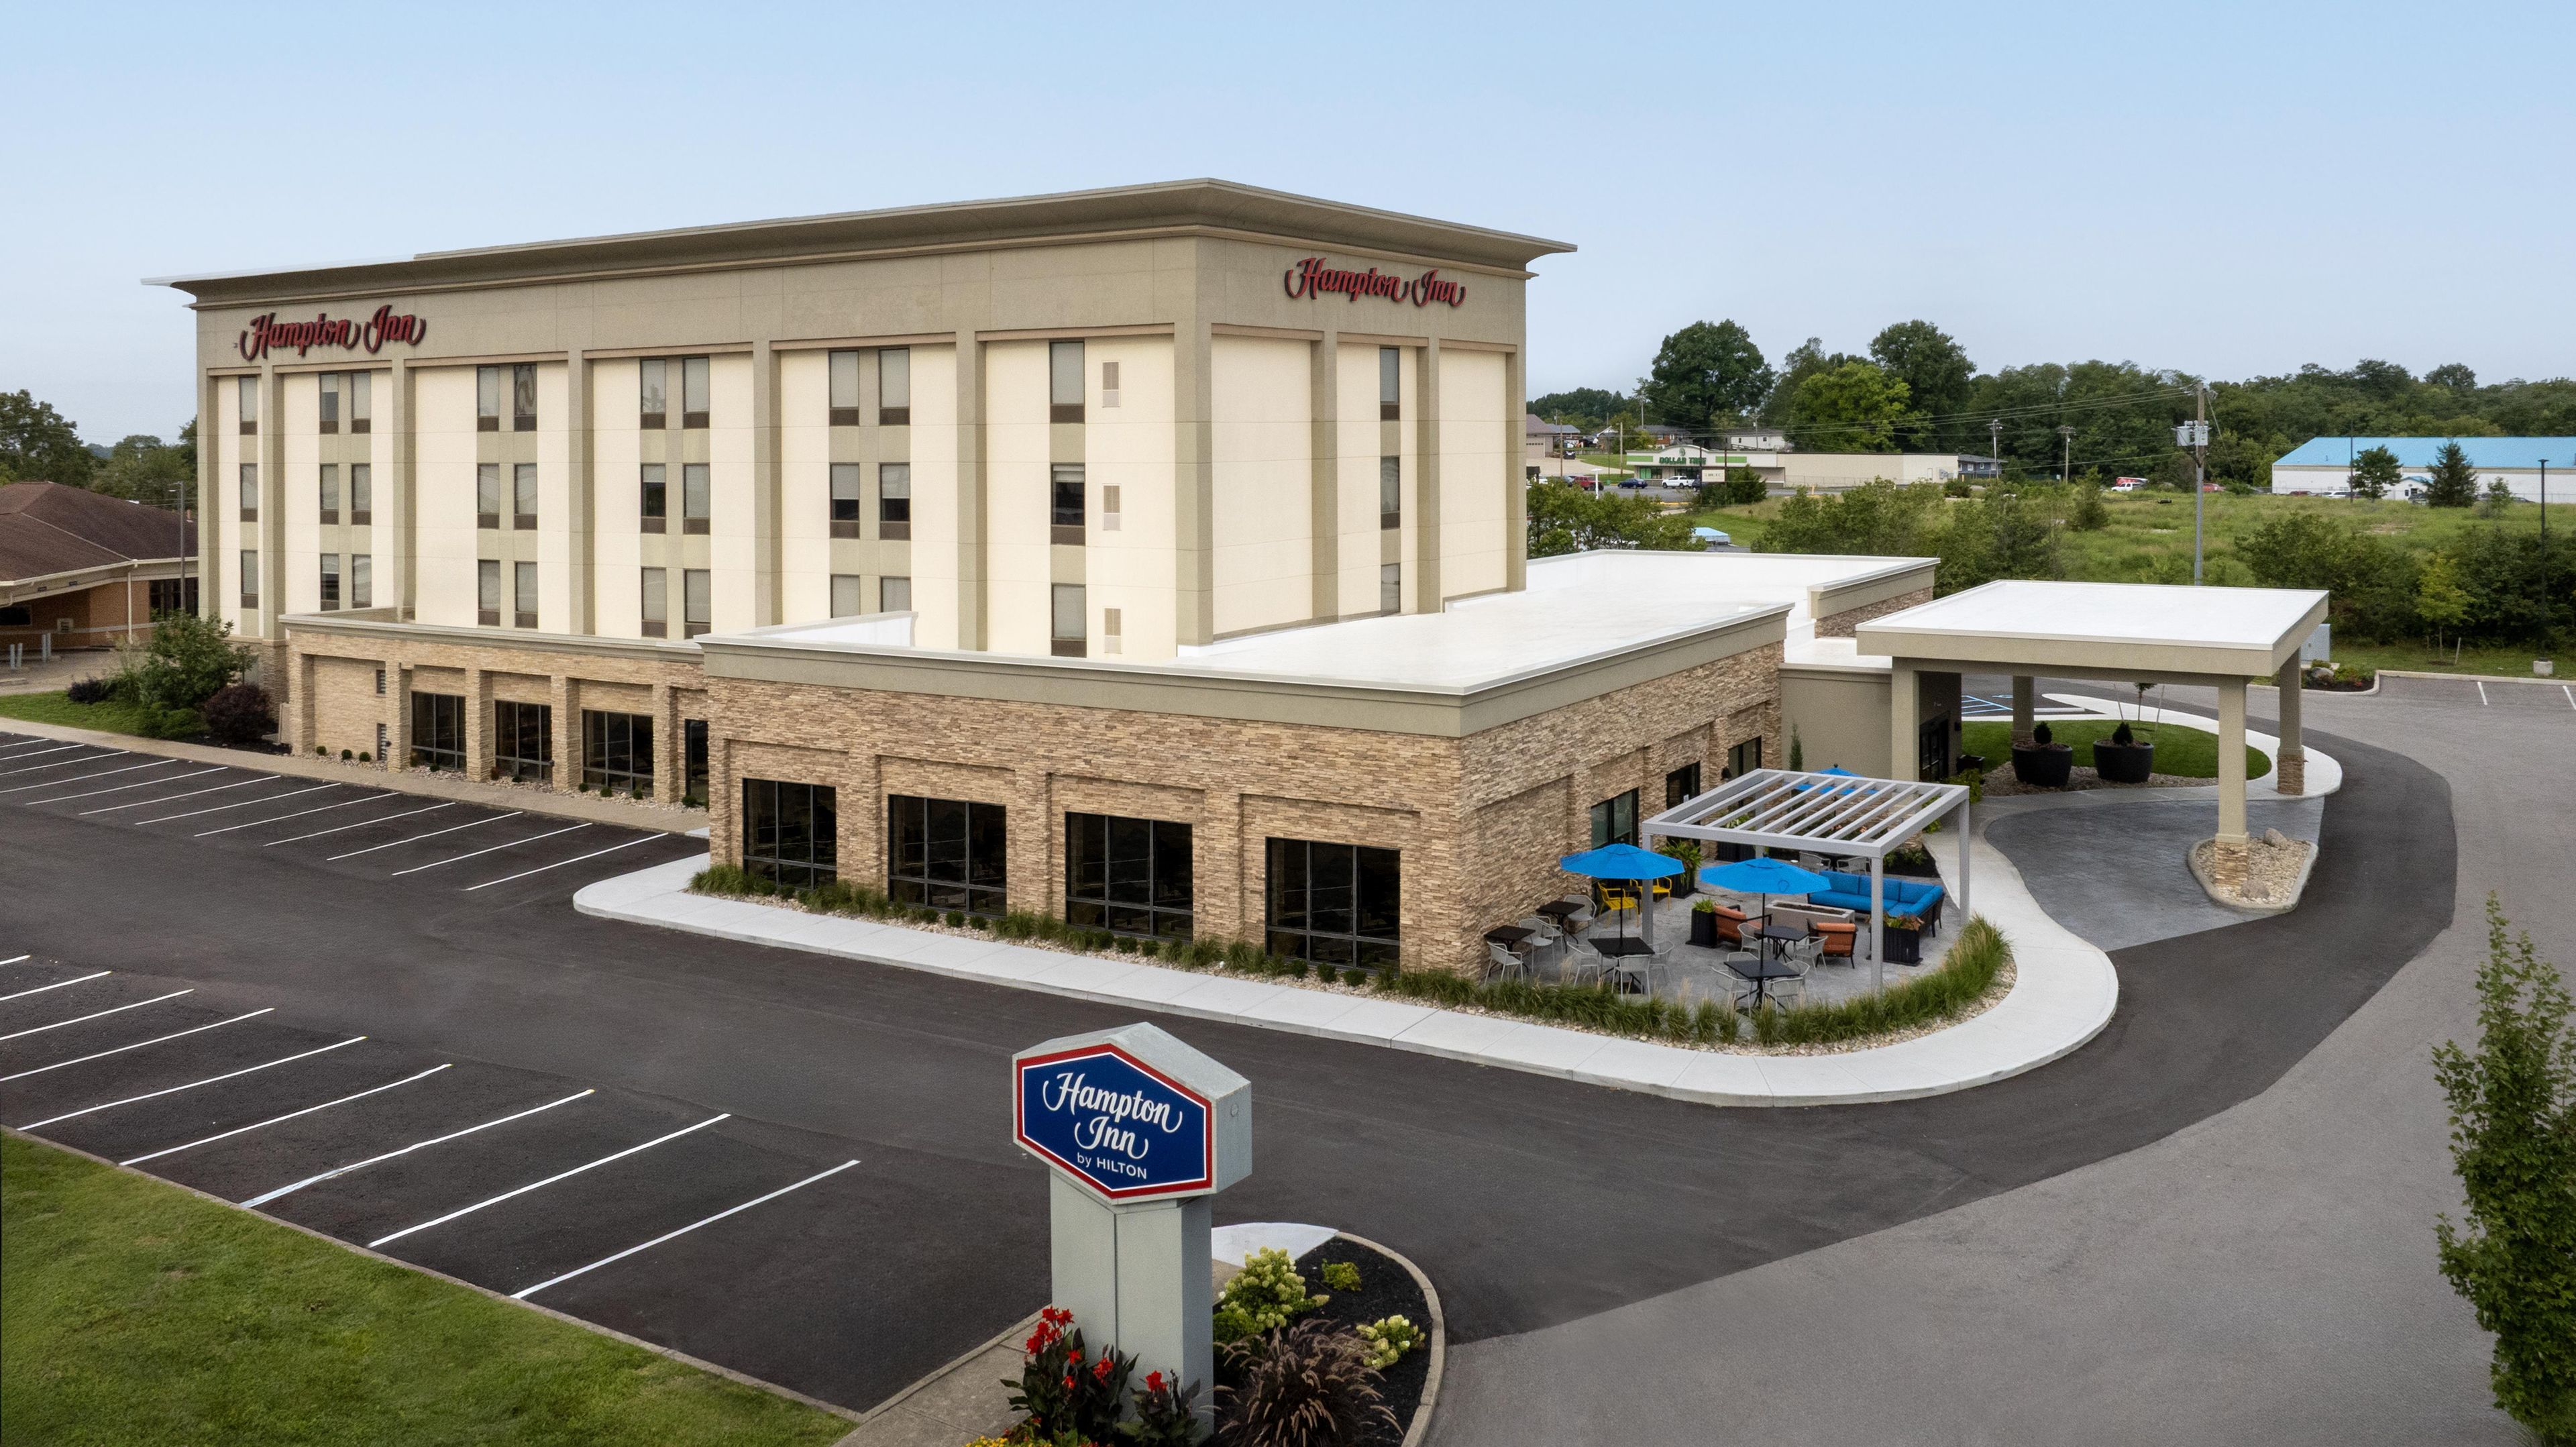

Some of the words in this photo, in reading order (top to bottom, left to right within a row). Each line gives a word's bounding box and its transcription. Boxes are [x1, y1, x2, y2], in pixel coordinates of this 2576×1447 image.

[1285, 258, 1410, 302] Hampton
[1412, 269, 1466, 307] Inn
[239, 313, 361, 360] Hampton
[364, 305, 427, 354] Inn
[1043, 1073, 1183, 1133] Hampton
[1075, 1116, 1148, 1159] Inn
[1077, 1153, 1092, 1167] by
[1097, 1157, 1147, 1179] HILTON
